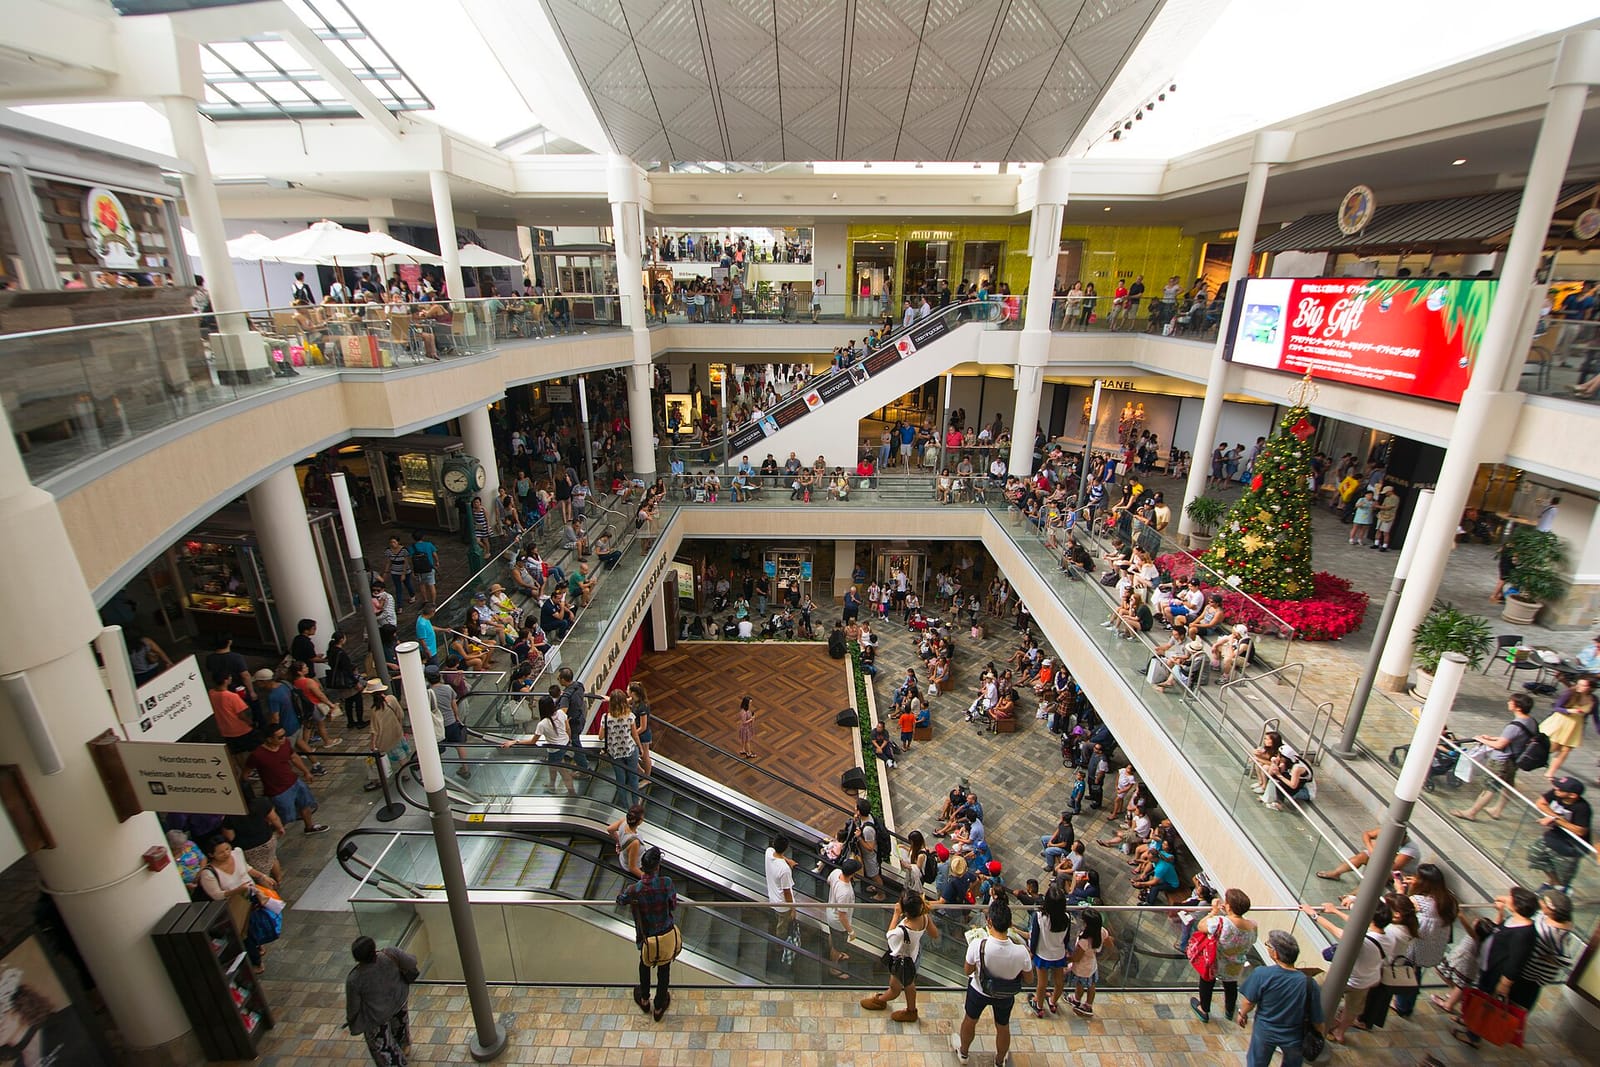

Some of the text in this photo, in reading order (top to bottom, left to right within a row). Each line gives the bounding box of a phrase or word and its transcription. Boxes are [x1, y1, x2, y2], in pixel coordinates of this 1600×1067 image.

[911, 231, 953, 240] miu miu
[1292, 294, 1369, 338] Big Gift
[621, 551, 667, 642] CENTERSTAGE
[157, 680, 186, 702] Elevator
[152, 694, 191, 722] Escalator to
[168, 704, 187, 720] Level
[158, 755, 207, 764] Nordstrom
[139, 769, 212, 780] Neiman Marcus
[167, 784, 217, 794] Restrooms
